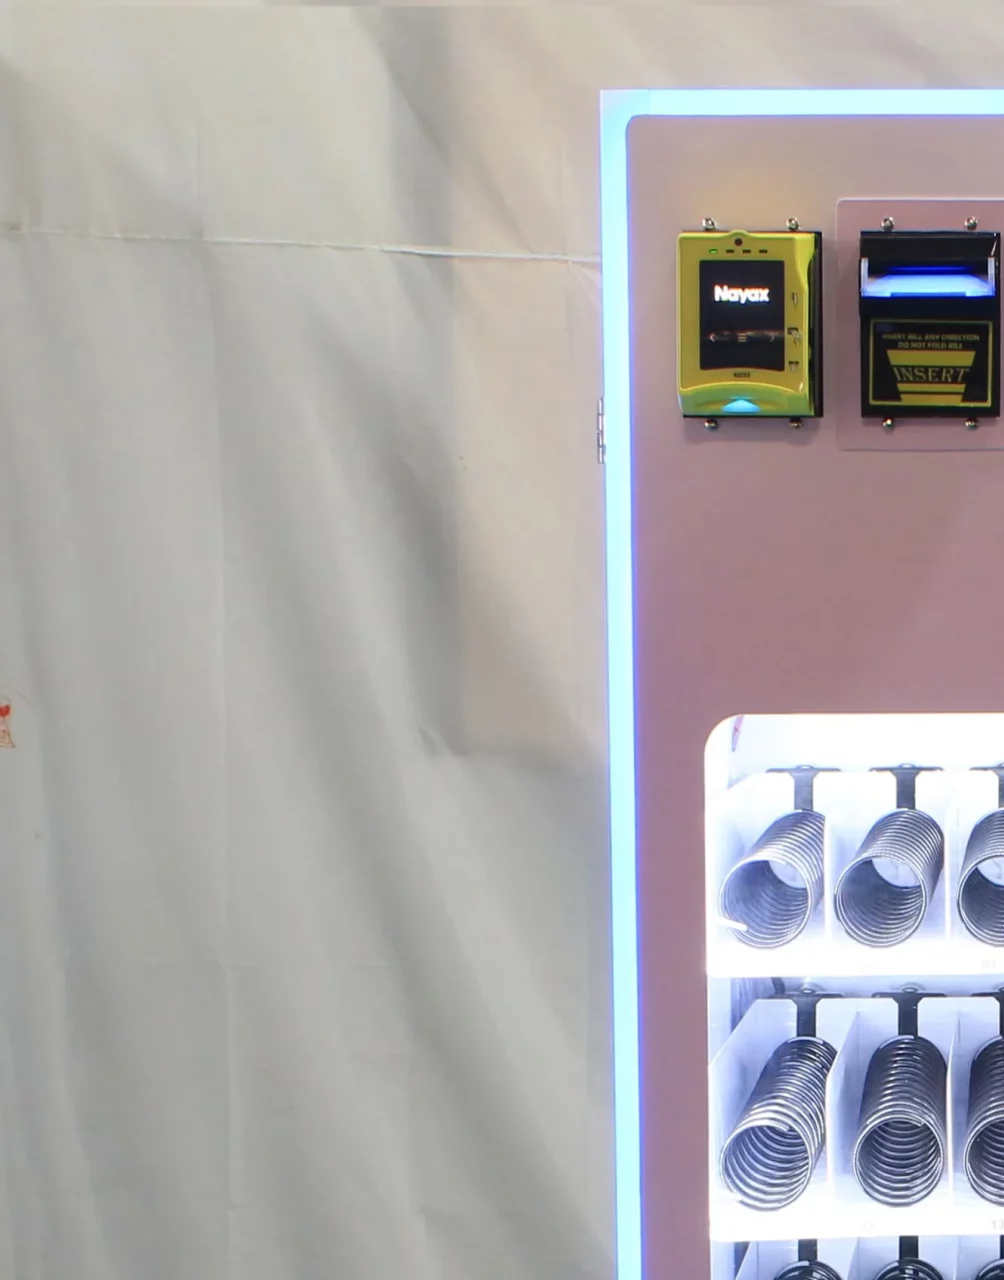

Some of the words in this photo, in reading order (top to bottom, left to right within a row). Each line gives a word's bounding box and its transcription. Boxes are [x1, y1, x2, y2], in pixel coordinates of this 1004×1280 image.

[714, 284, 770, 304] Nayax
[924, 333, 940, 341] ANY
[941, 333, 980, 342] DIRECTION
[898, 341, 909, 349] DO
[911, 341, 926, 349] NOT
[928, 341, 946, 349] FOLD
[948, 341, 963, 349] BILL
[893, 366, 970, 383] INSERT
[992, 1219, 1004, 1230] 13
